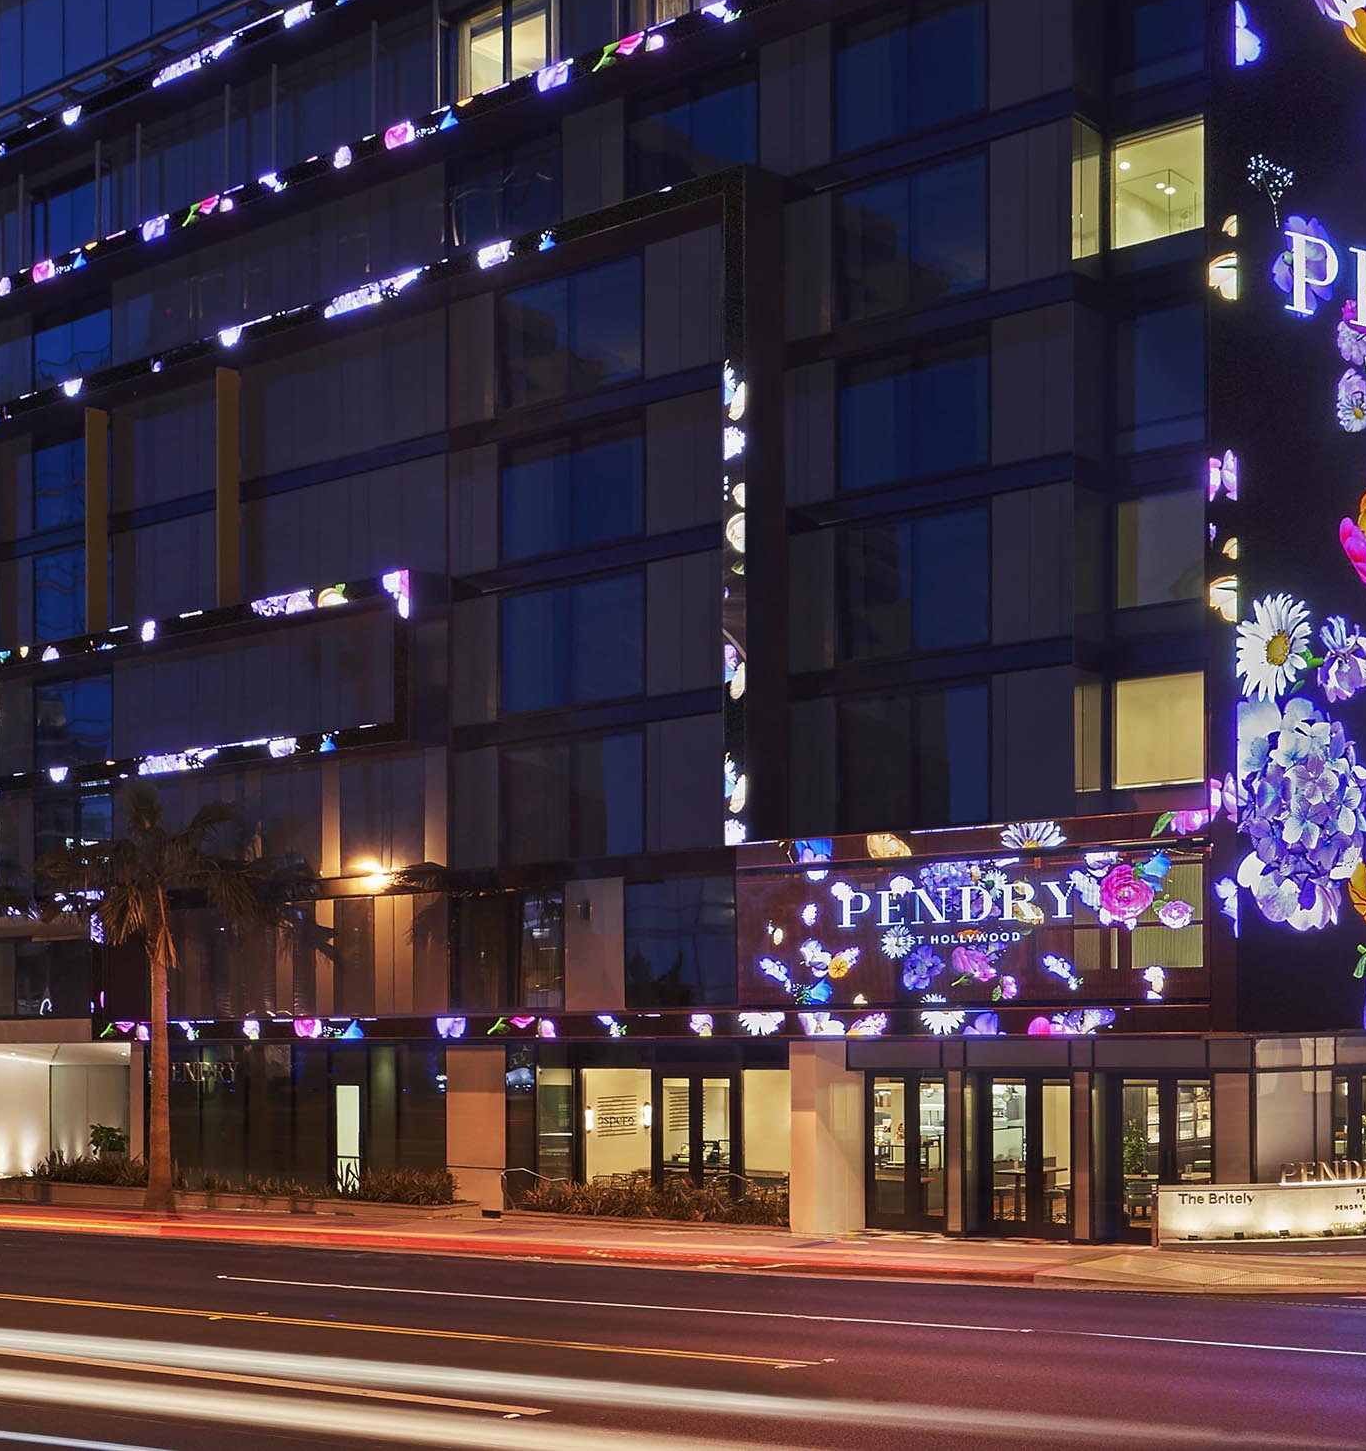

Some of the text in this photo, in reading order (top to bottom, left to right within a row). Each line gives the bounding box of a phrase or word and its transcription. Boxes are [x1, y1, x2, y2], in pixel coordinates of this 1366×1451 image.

[837, 881, 1075, 928] PENDRY
[930, 932, 1021, 945] HOLLYWOOD
[1178, 1191, 1255, 1206] The Britely
